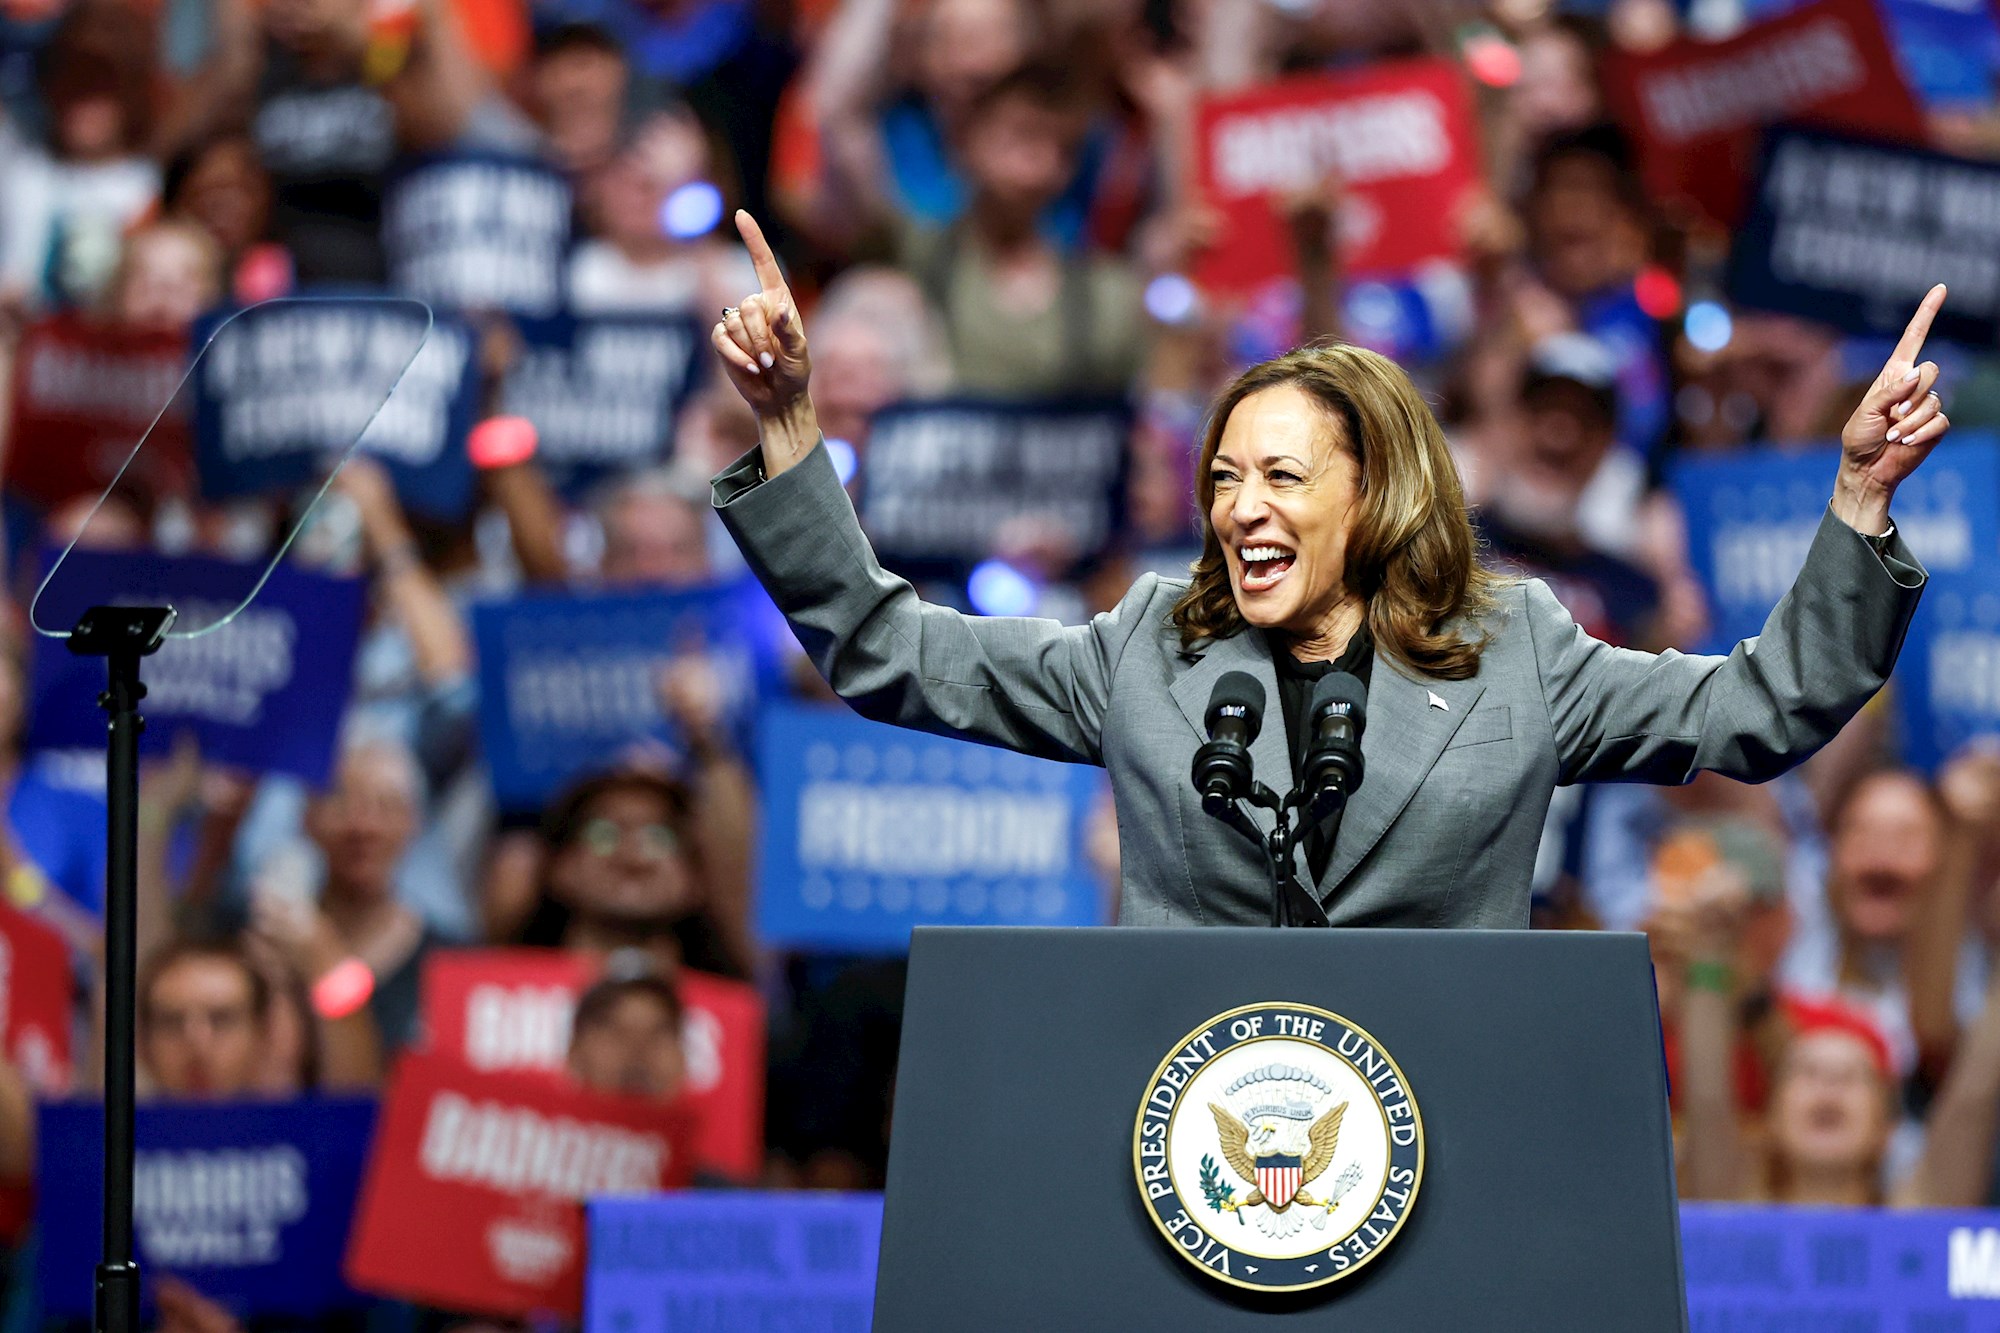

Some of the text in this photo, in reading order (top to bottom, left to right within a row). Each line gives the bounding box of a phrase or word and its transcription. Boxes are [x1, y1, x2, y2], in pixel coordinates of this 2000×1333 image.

[1141, 1014, 1417, 1276] VICE PRESIDENT OF THE UNITED STATES
[1250, 1104, 1288, 1116] PLURIBUS
